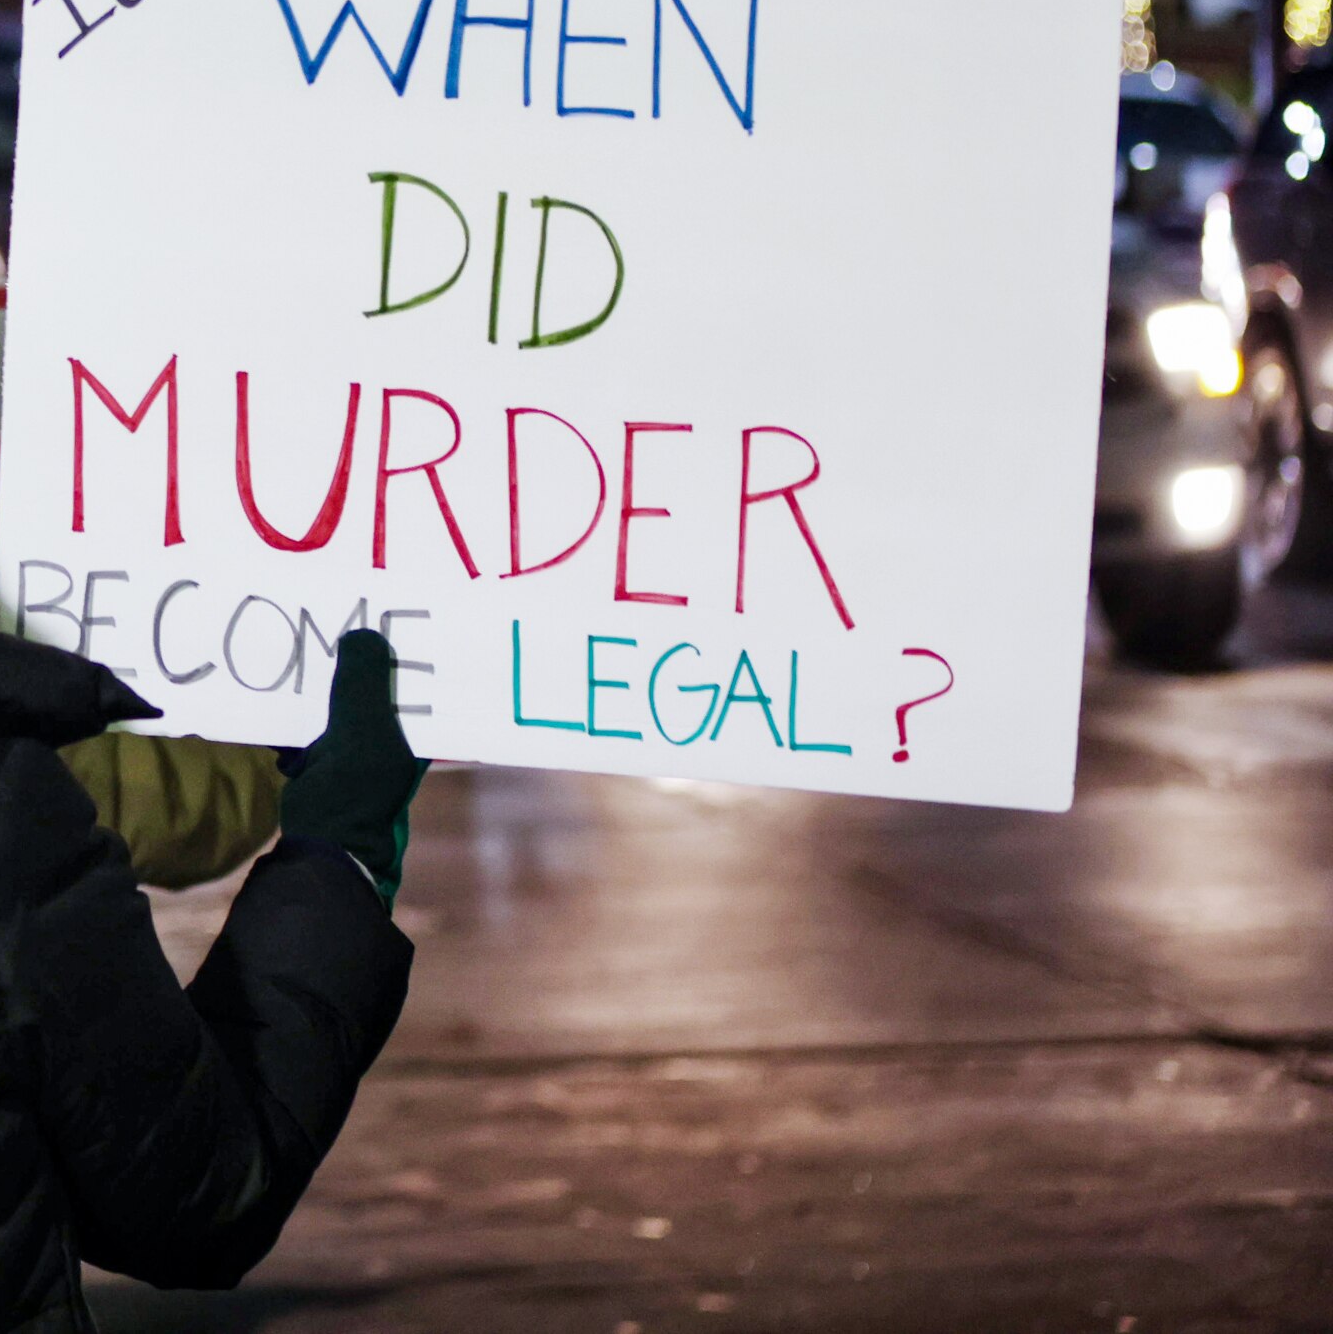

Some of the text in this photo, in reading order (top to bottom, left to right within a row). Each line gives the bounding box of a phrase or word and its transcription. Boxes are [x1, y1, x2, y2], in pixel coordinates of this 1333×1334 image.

[361, 170, 625, 349] DID
[68, 354, 855, 631] MURDER
[15, 559, 435, 718] BECOME
